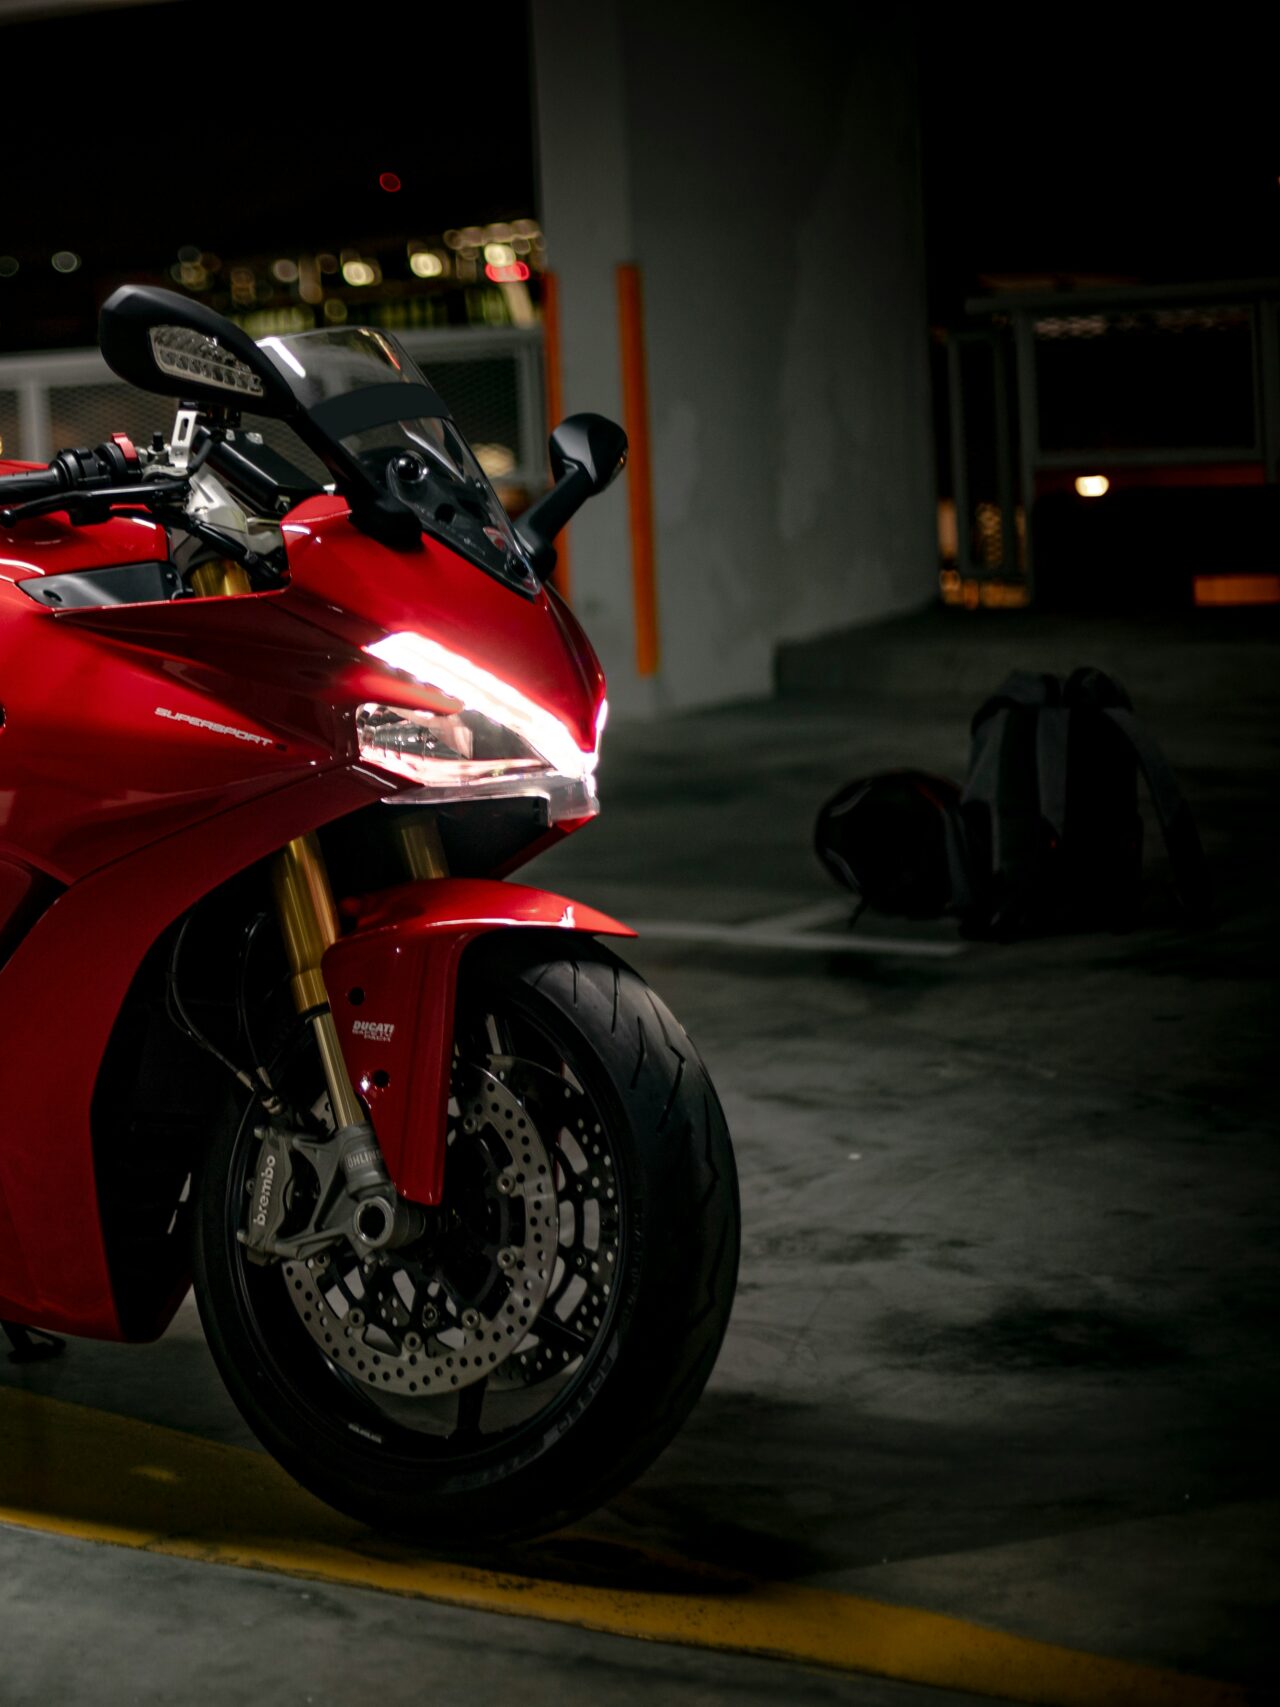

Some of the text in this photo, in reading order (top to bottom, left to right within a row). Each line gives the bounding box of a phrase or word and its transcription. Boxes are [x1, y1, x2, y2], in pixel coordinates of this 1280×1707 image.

[155, 707, 273, 746] SUPERSPORT
[352, 1020, 395, 1033] DUCATI
[253, 1155, 276, 1226] brembo
